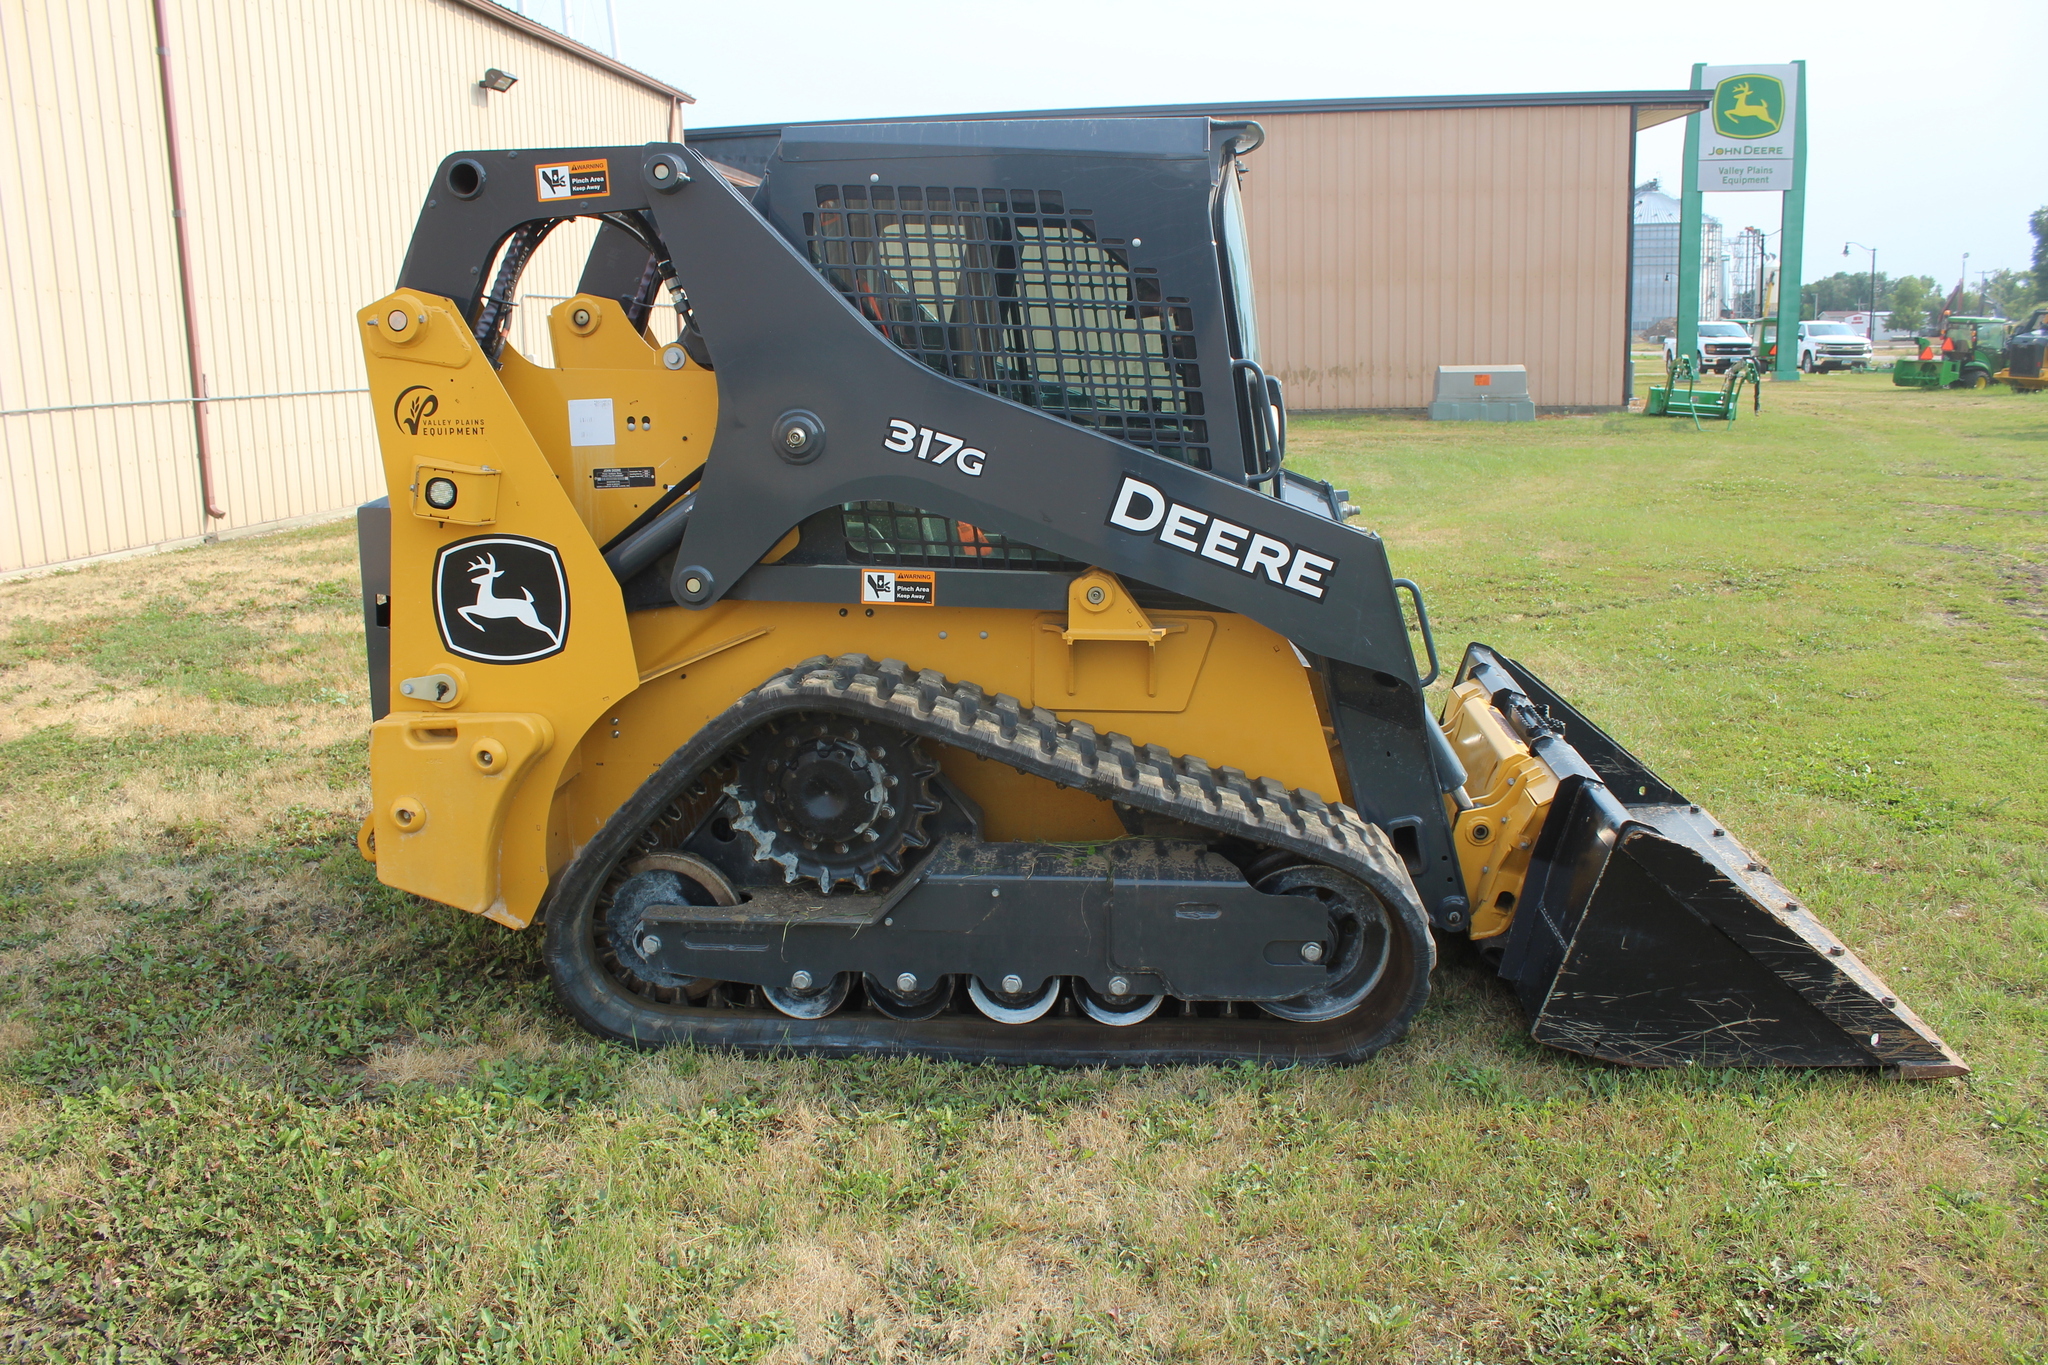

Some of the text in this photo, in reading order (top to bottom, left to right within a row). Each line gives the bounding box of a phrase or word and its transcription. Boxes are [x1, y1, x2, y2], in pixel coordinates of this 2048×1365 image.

[1708, 145, 1783, 156] JOHN DEERE
[1718, 166, 1773, 175] Valley Plains
[1722, 176, 1769, 185] Equipment
[423, 427, 485, 437] EQUIPMENT
[884, 419, 986, 476] 317G
[1109, 476, 1335, 599] DEERE
